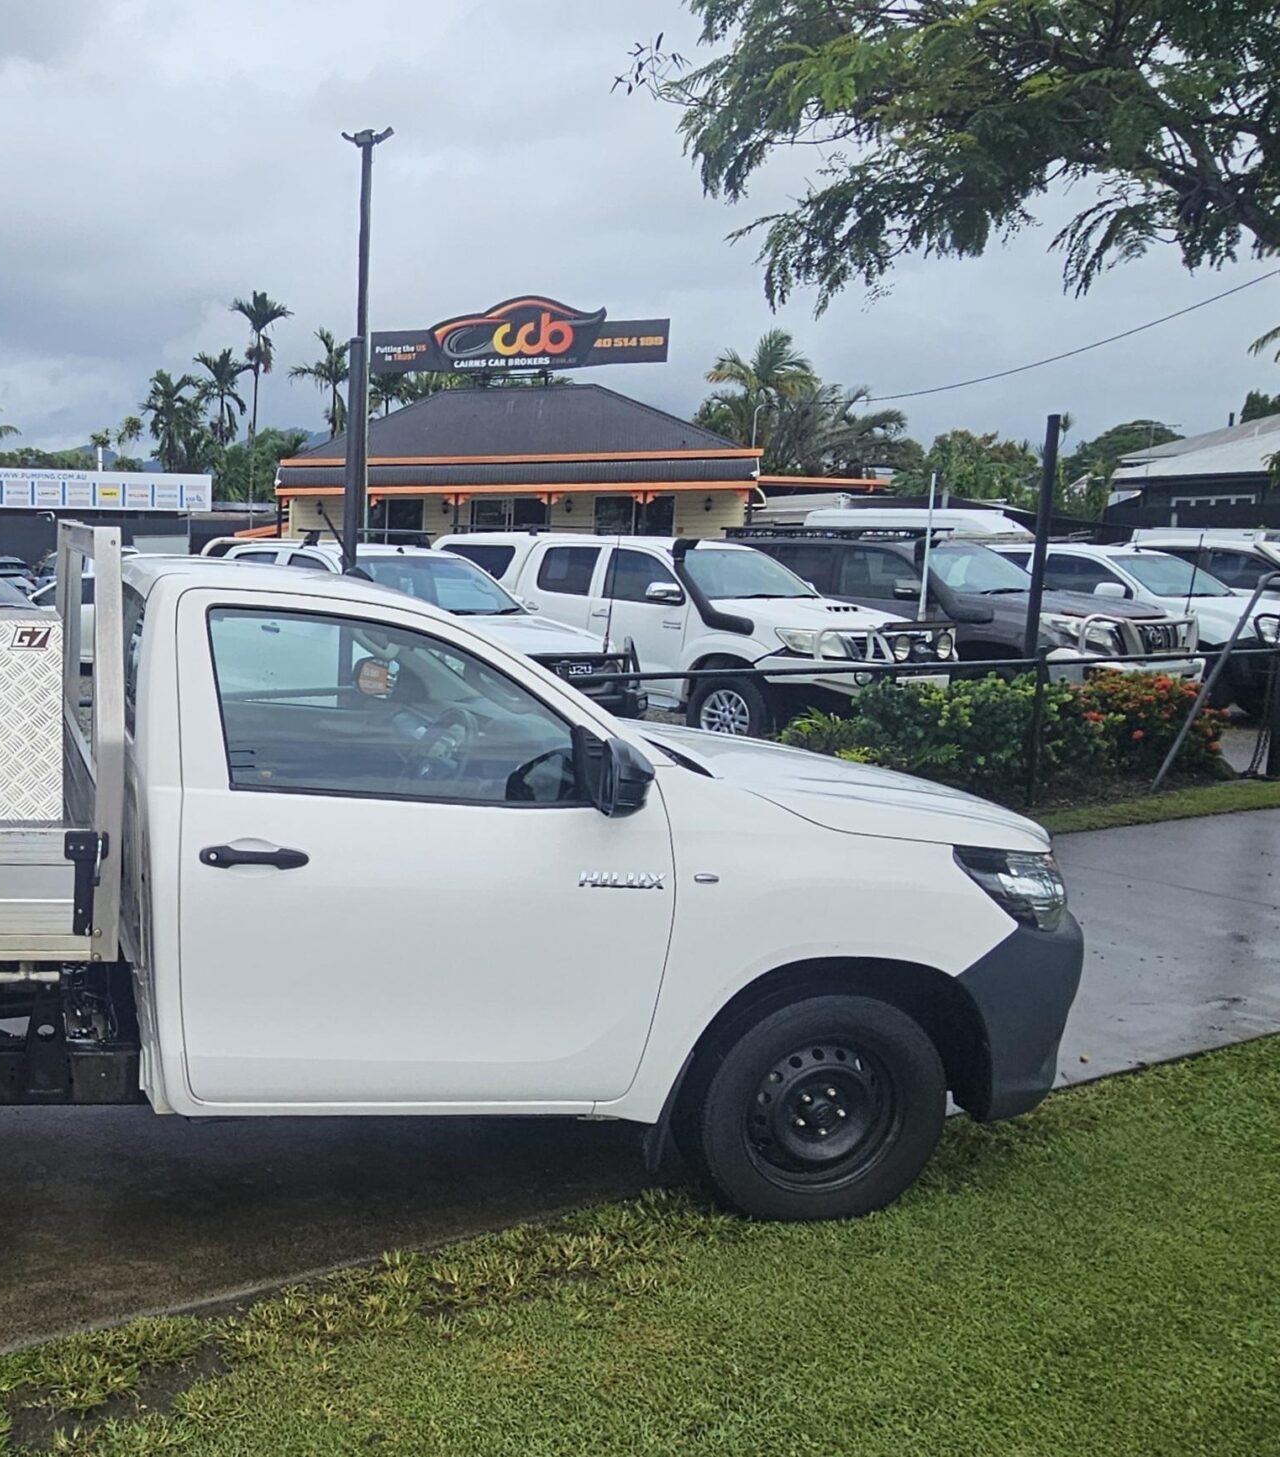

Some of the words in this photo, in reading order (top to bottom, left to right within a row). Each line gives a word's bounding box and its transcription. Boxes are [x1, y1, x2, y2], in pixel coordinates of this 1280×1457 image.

[454, 359, 487, 368] CAIRNS
[488, 358, 506, 367] CAR
[12, 627, 51, 647] G7
[555, 665, 593, 675] IUZU
[578, 871, 665, 890] HILUX
